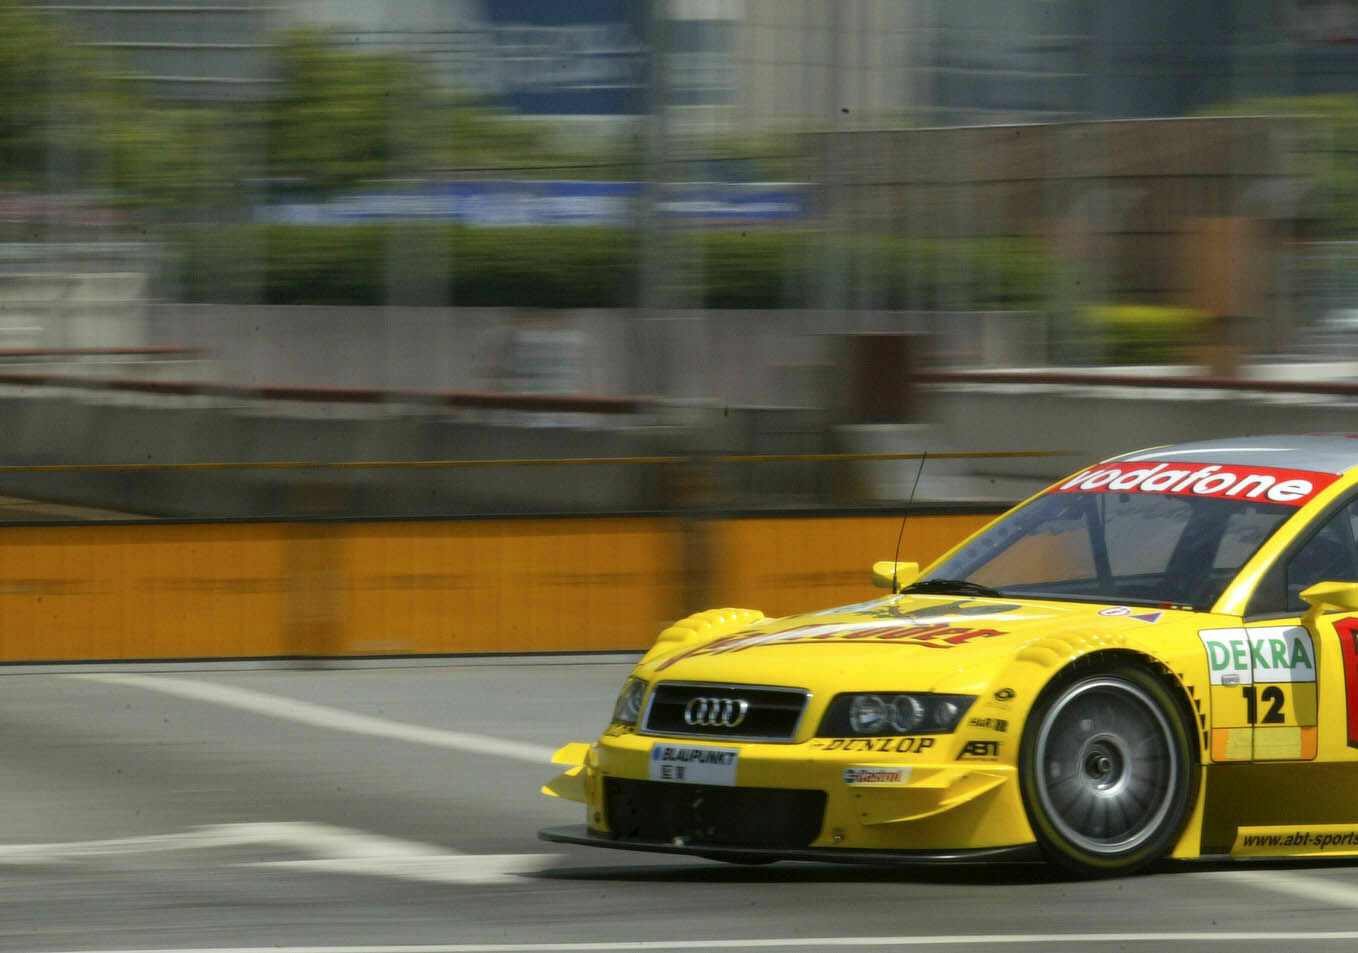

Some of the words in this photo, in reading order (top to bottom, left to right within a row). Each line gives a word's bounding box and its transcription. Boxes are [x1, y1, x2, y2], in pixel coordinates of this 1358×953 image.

[1058, 462, 1314, 502] vodafone
[1206, 637, 1313, 671] DEKRA
[1242, 685, 1286, 725] 12
[661, 747, 738, 766] BLAUPUNKT
[821, 737, 937, 754] DUNLOP
[955, 740, 1000, 761] ABT
